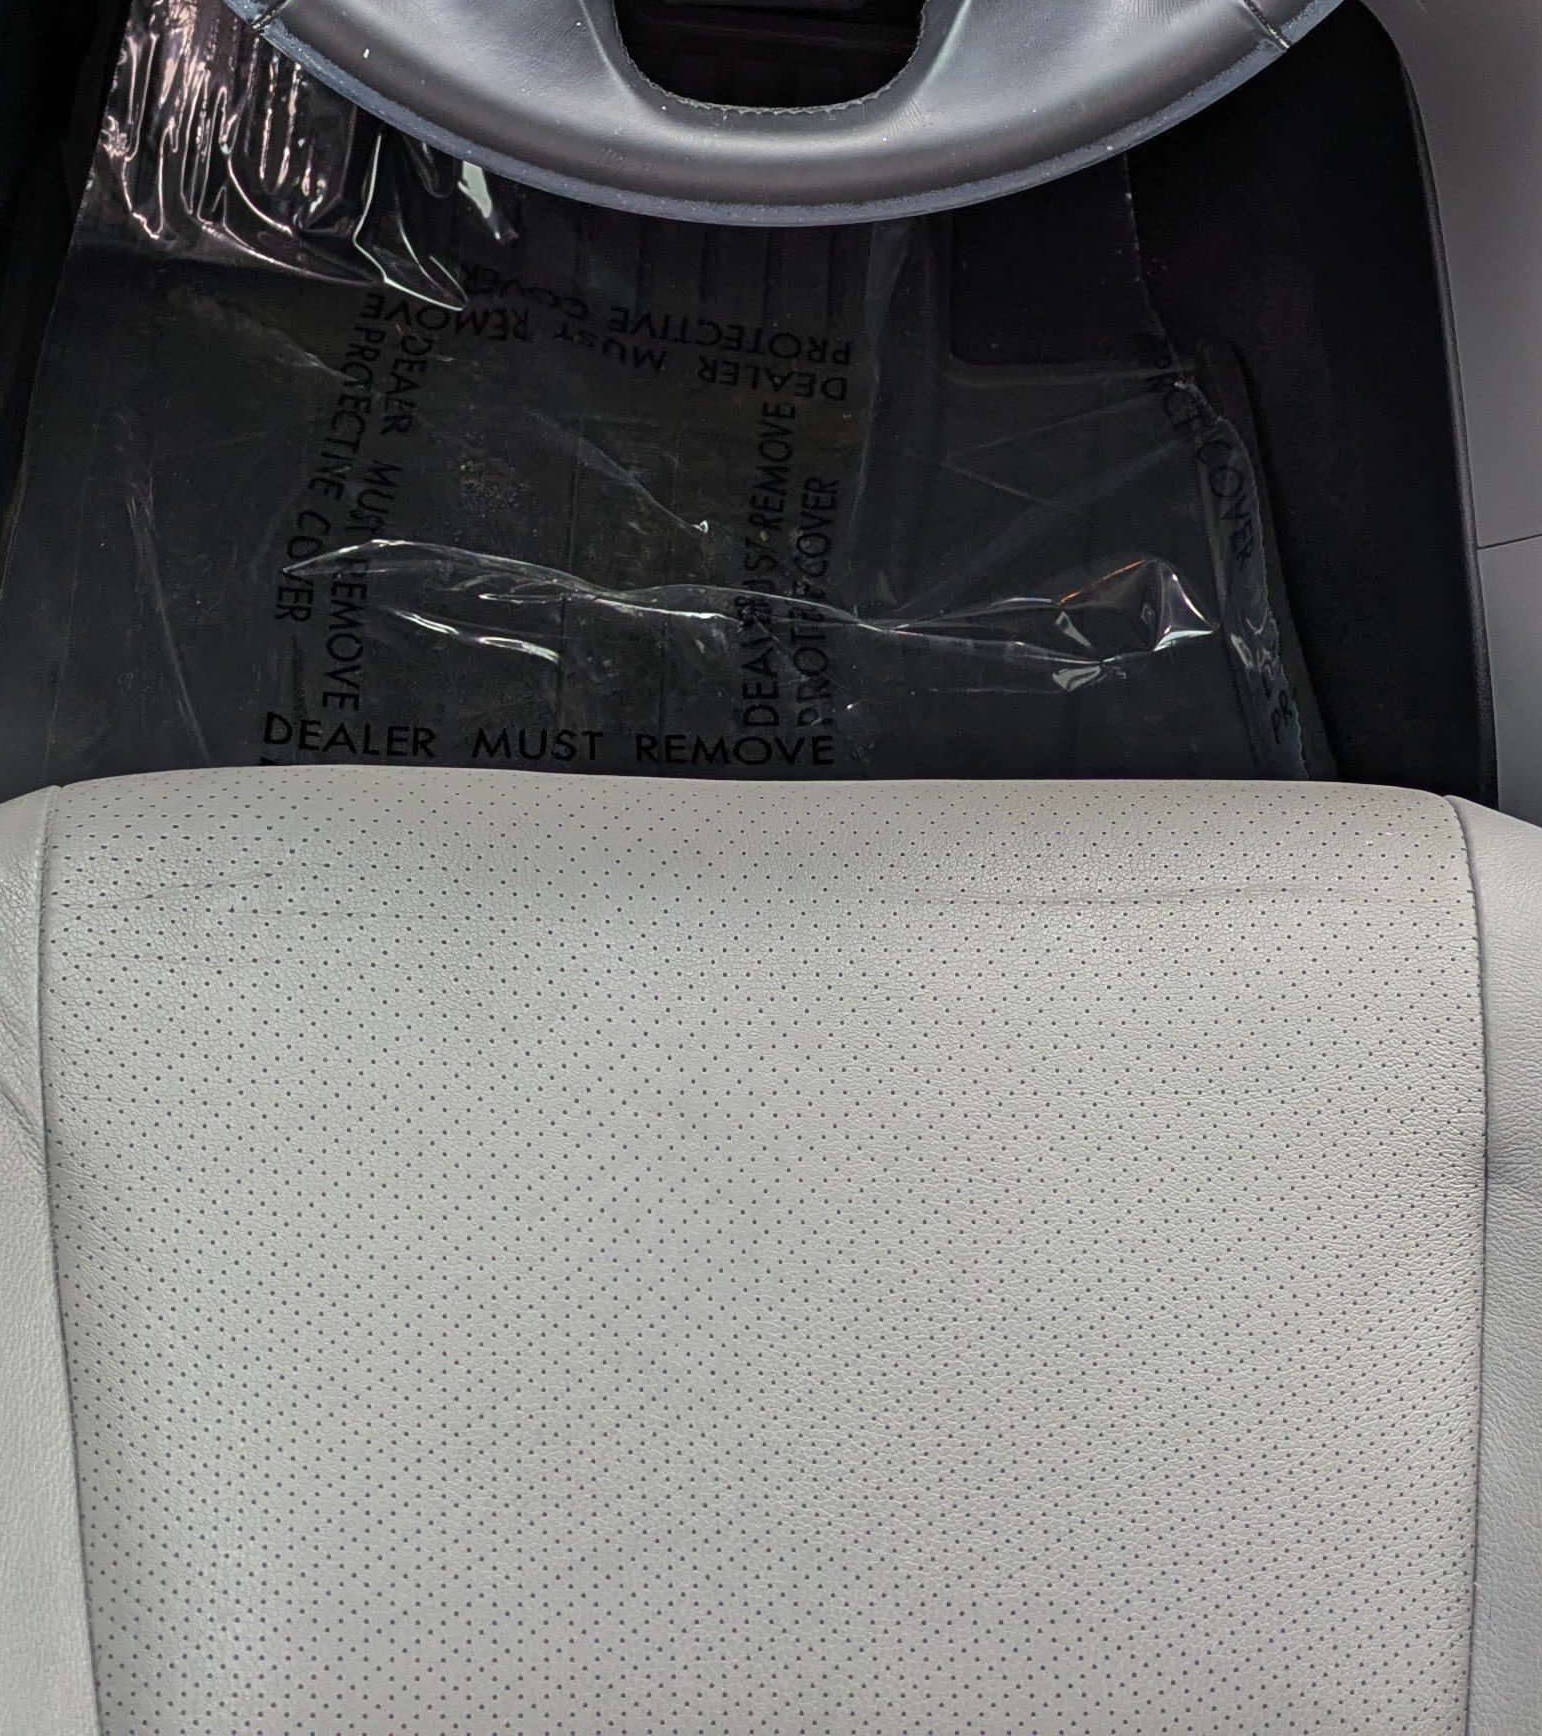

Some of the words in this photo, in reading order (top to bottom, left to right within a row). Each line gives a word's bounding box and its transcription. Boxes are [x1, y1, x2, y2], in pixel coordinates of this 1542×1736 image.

[698, 356, 849, 403] DEALER
[274, 508, 332, 624] COVER
[262, 710, 436, 759] DEALER
[471, 727, 603, 762] MUST
[635, 733, 837, 766] REMOVE
